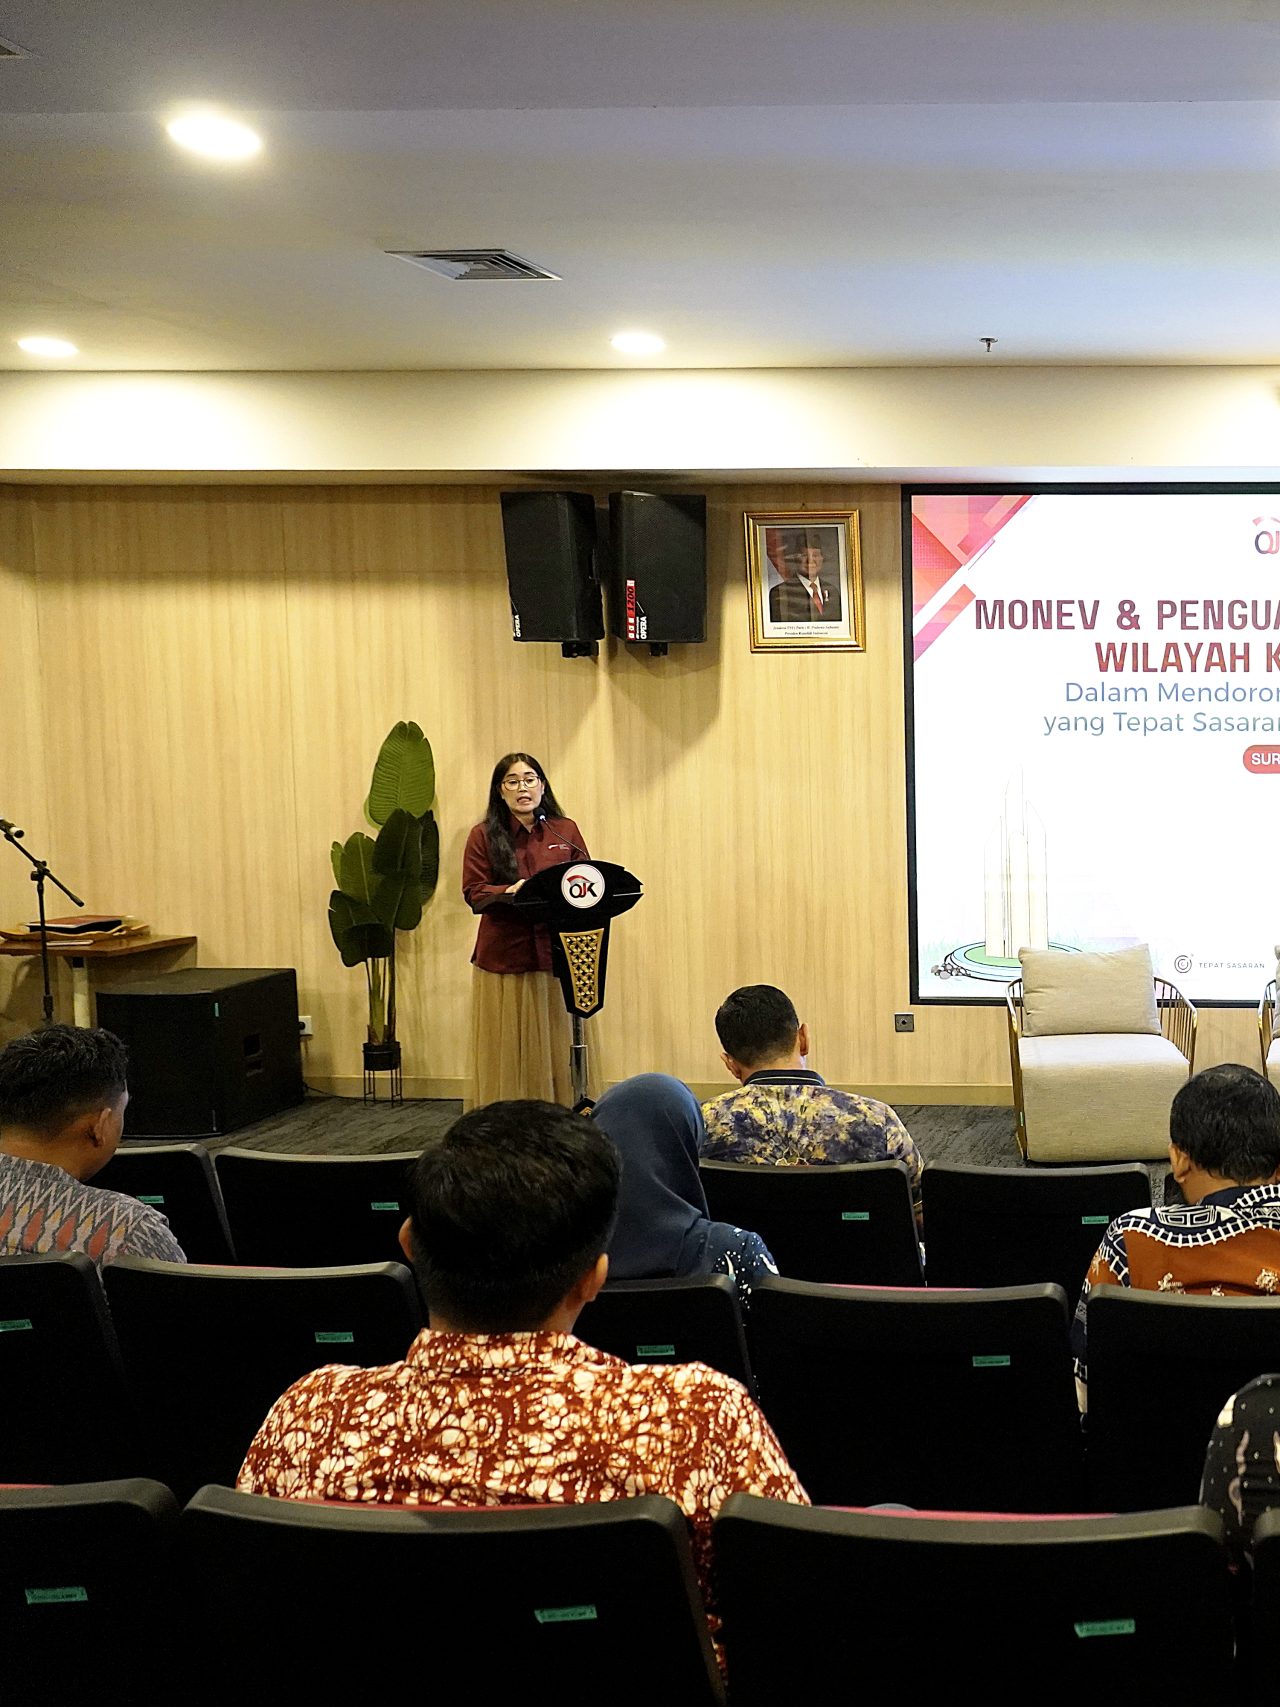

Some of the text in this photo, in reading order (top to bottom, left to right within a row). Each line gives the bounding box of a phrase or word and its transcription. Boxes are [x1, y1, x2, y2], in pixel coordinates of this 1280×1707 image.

[975, 599, 1100, 630] MONEV
[1116, 599, 1141, 630] &
[1094, 642, 1250, 673] WILAYAH
[1065, 682, 1148, 702] Dalam
[1043, 715, 1105, 736] yang
[1112, 712, 1185, 736] Tepat
[569, 882, 598, 898] OJK
